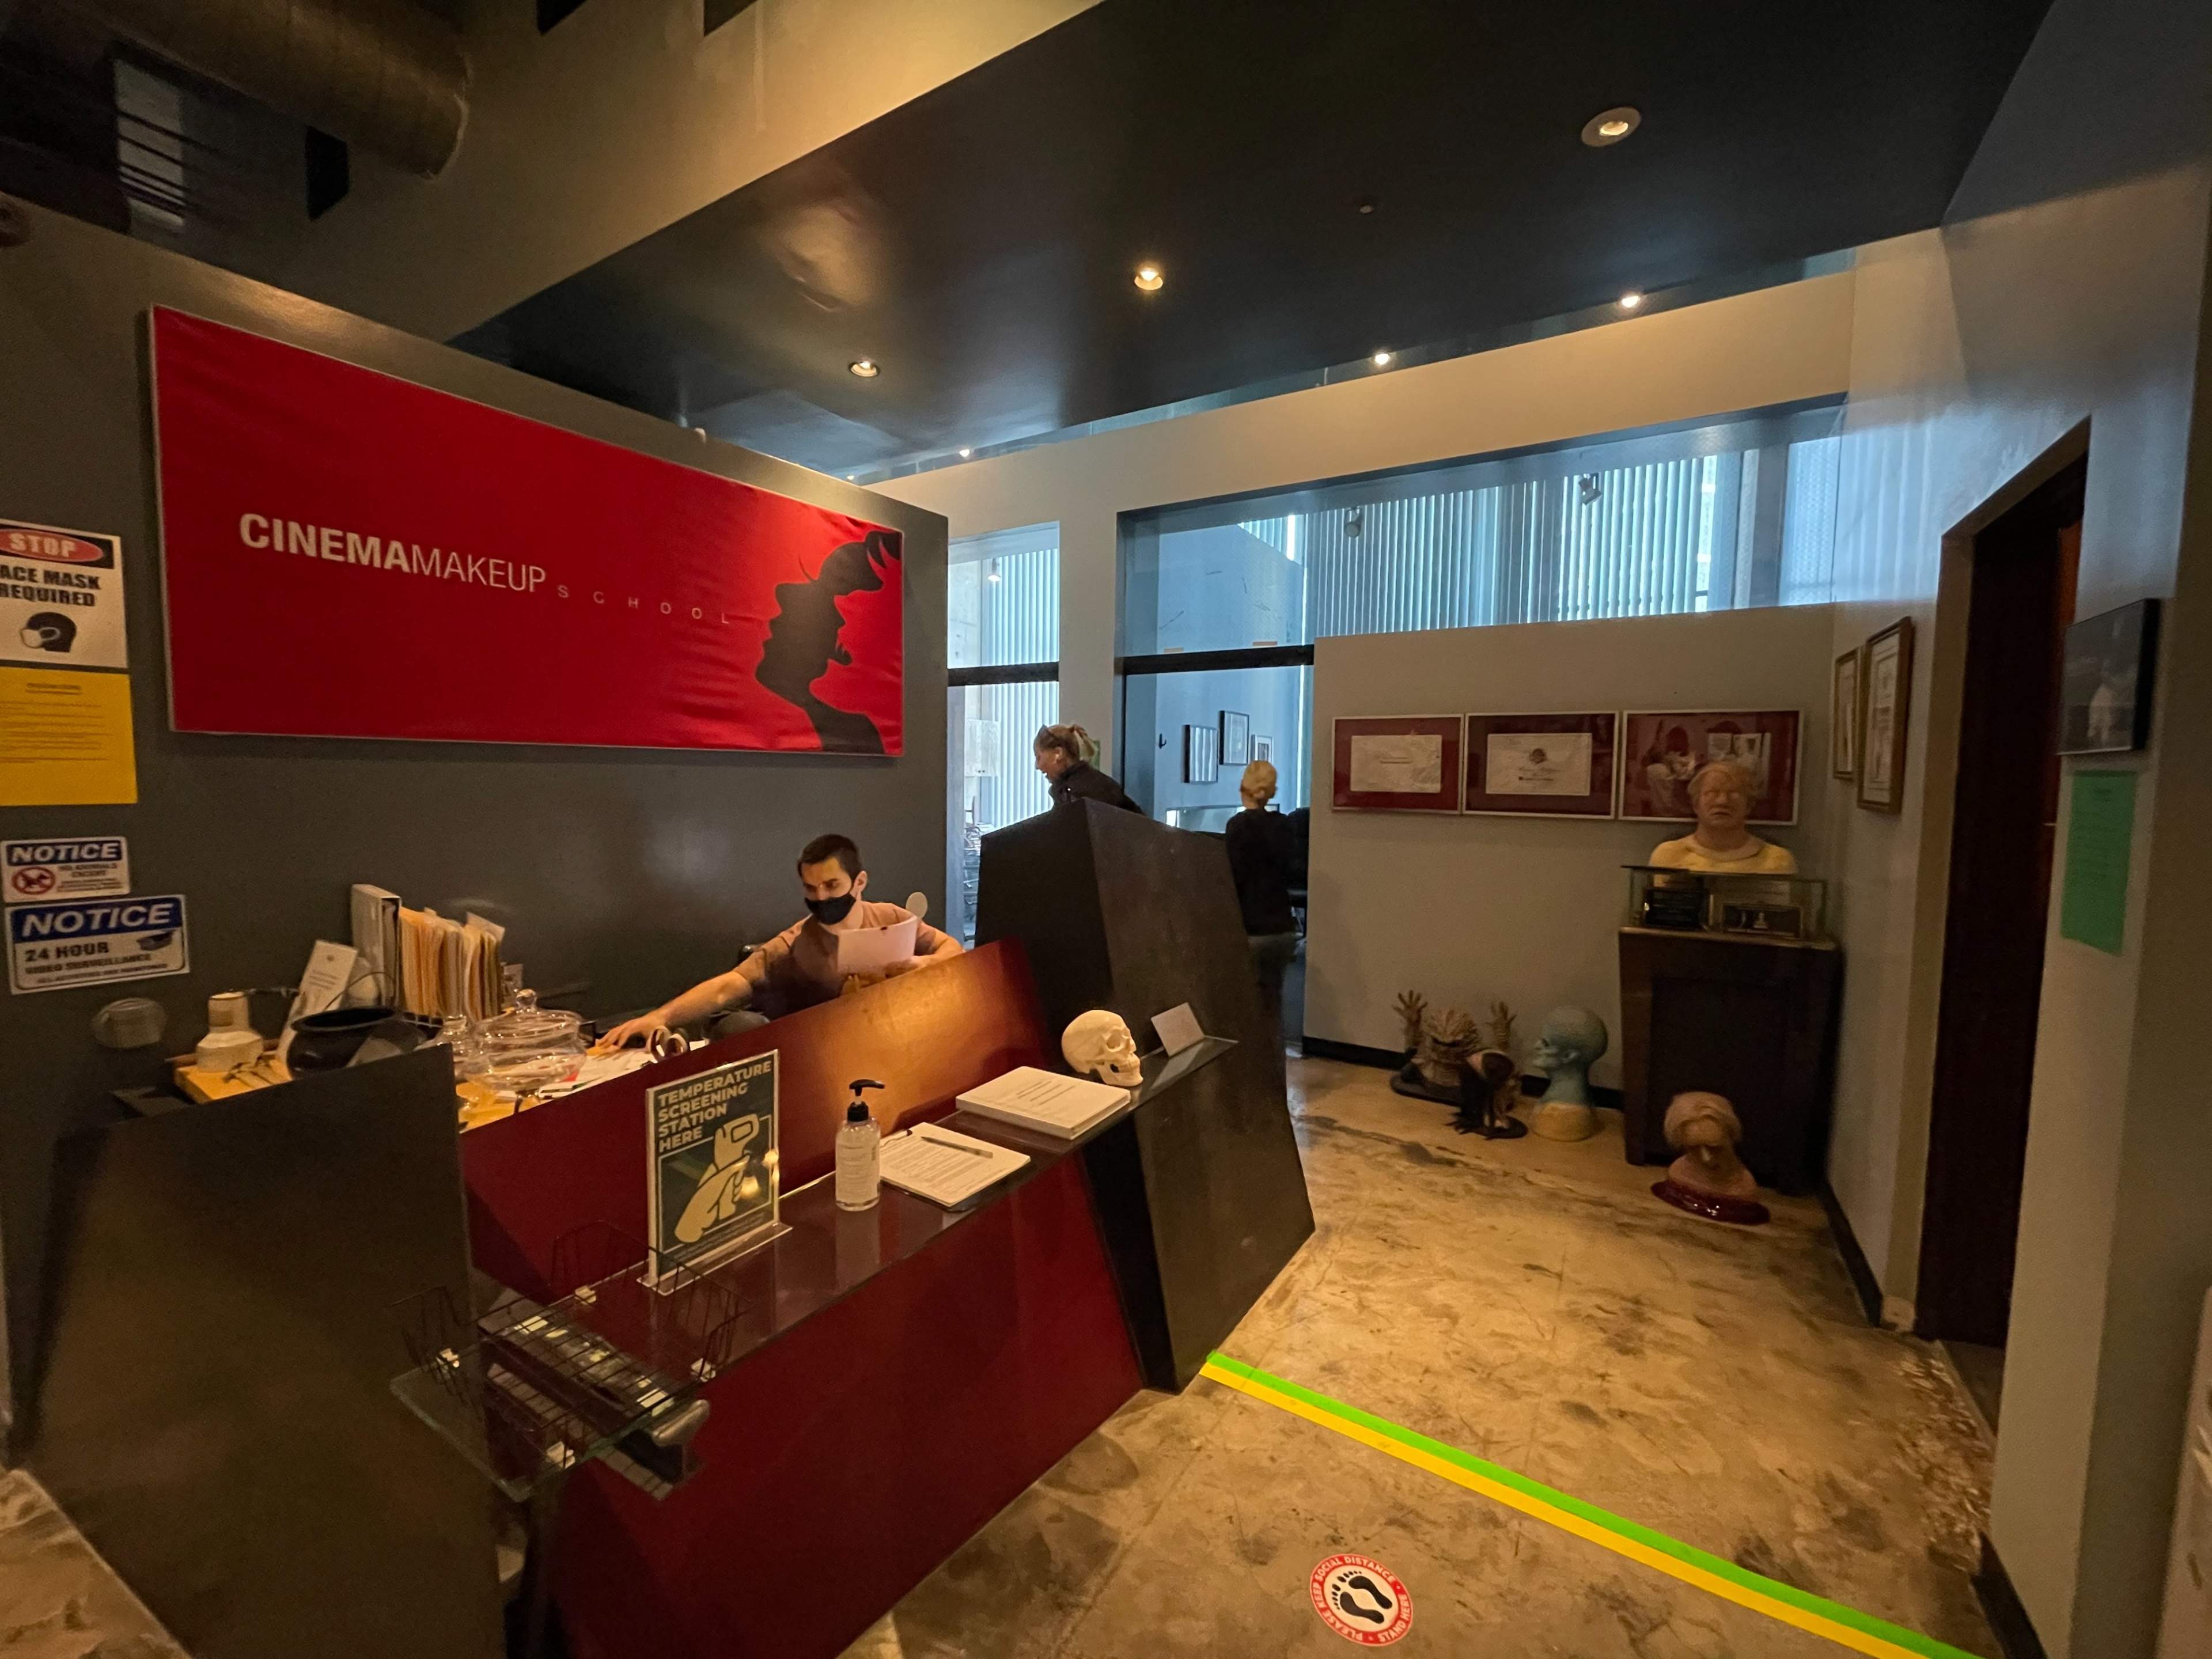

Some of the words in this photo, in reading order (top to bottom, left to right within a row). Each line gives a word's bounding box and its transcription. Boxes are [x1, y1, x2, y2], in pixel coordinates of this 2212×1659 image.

[9, 533, 75, 557] STOP
[44, 570, 100, 590] MASK
[0, 583, 95, 607] REQUIRED
[558, 585, 729, 624] SCHOOL
[12, 842, 119, 862] NOTICE
[21, 903, 174, 937] NOTICE
[25, 949, 49, 962] 24
[56, 941, 109, 959] HOUR
[658, 1060, 772, 1107] TEMPERATURE
[658, 1082, 748, 1122] SCREENING
[658, 1103, 727, 1137] STATION
[659, 1126, 702, 1153] HERE
[1315, 1557, 1343, 1582] SOCIAL
[1344, 1556, 1396, 1584] DISTANCE
[1313, 1582, 1327, 1608] KEEP
[1321, 1609, 1363, 1641] PLEASE
[1377, 1620, 1407, 1642] STAND
[1398, 1594, 1410, 1620] HERE
